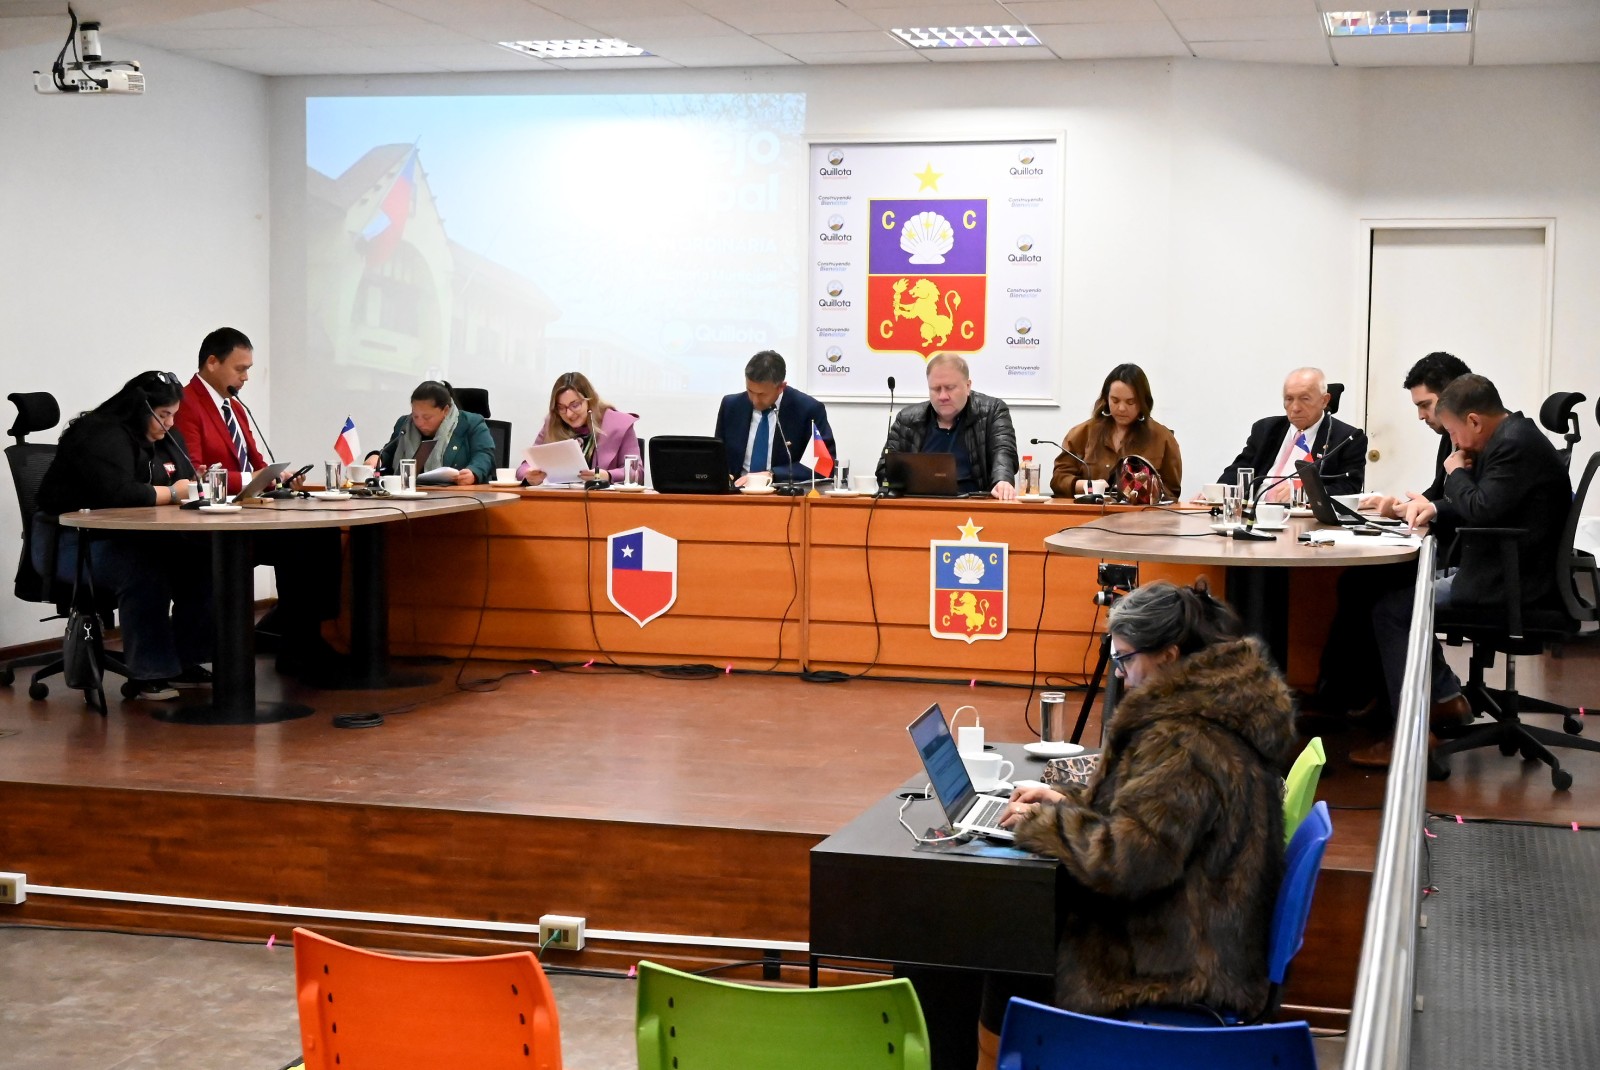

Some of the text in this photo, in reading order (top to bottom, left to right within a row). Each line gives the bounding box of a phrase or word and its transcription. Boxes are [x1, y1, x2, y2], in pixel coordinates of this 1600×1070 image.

[819, 168, 851, 176] Quillota
[1009, 167, 1043, 176] Quillota
[881, 211, 895, 230] C
[963, 210, 977, 229] C
[819, 233, 852, 242] Quillota
[1008, 254, 1042, 263] Quillota
[819, 299, 851, 308] Quillota
[880, 320, 893, 338] C
[960, 320, 974, 339] C
[1006, 337, 1040, 346] Quillota
[818, 365, 850, 373] Quillota
[943, 552, 950, 563] C
[990, 553, 997, 564] C
[942, 615, 950, 626] C
[989, 617, 997, 628] C
